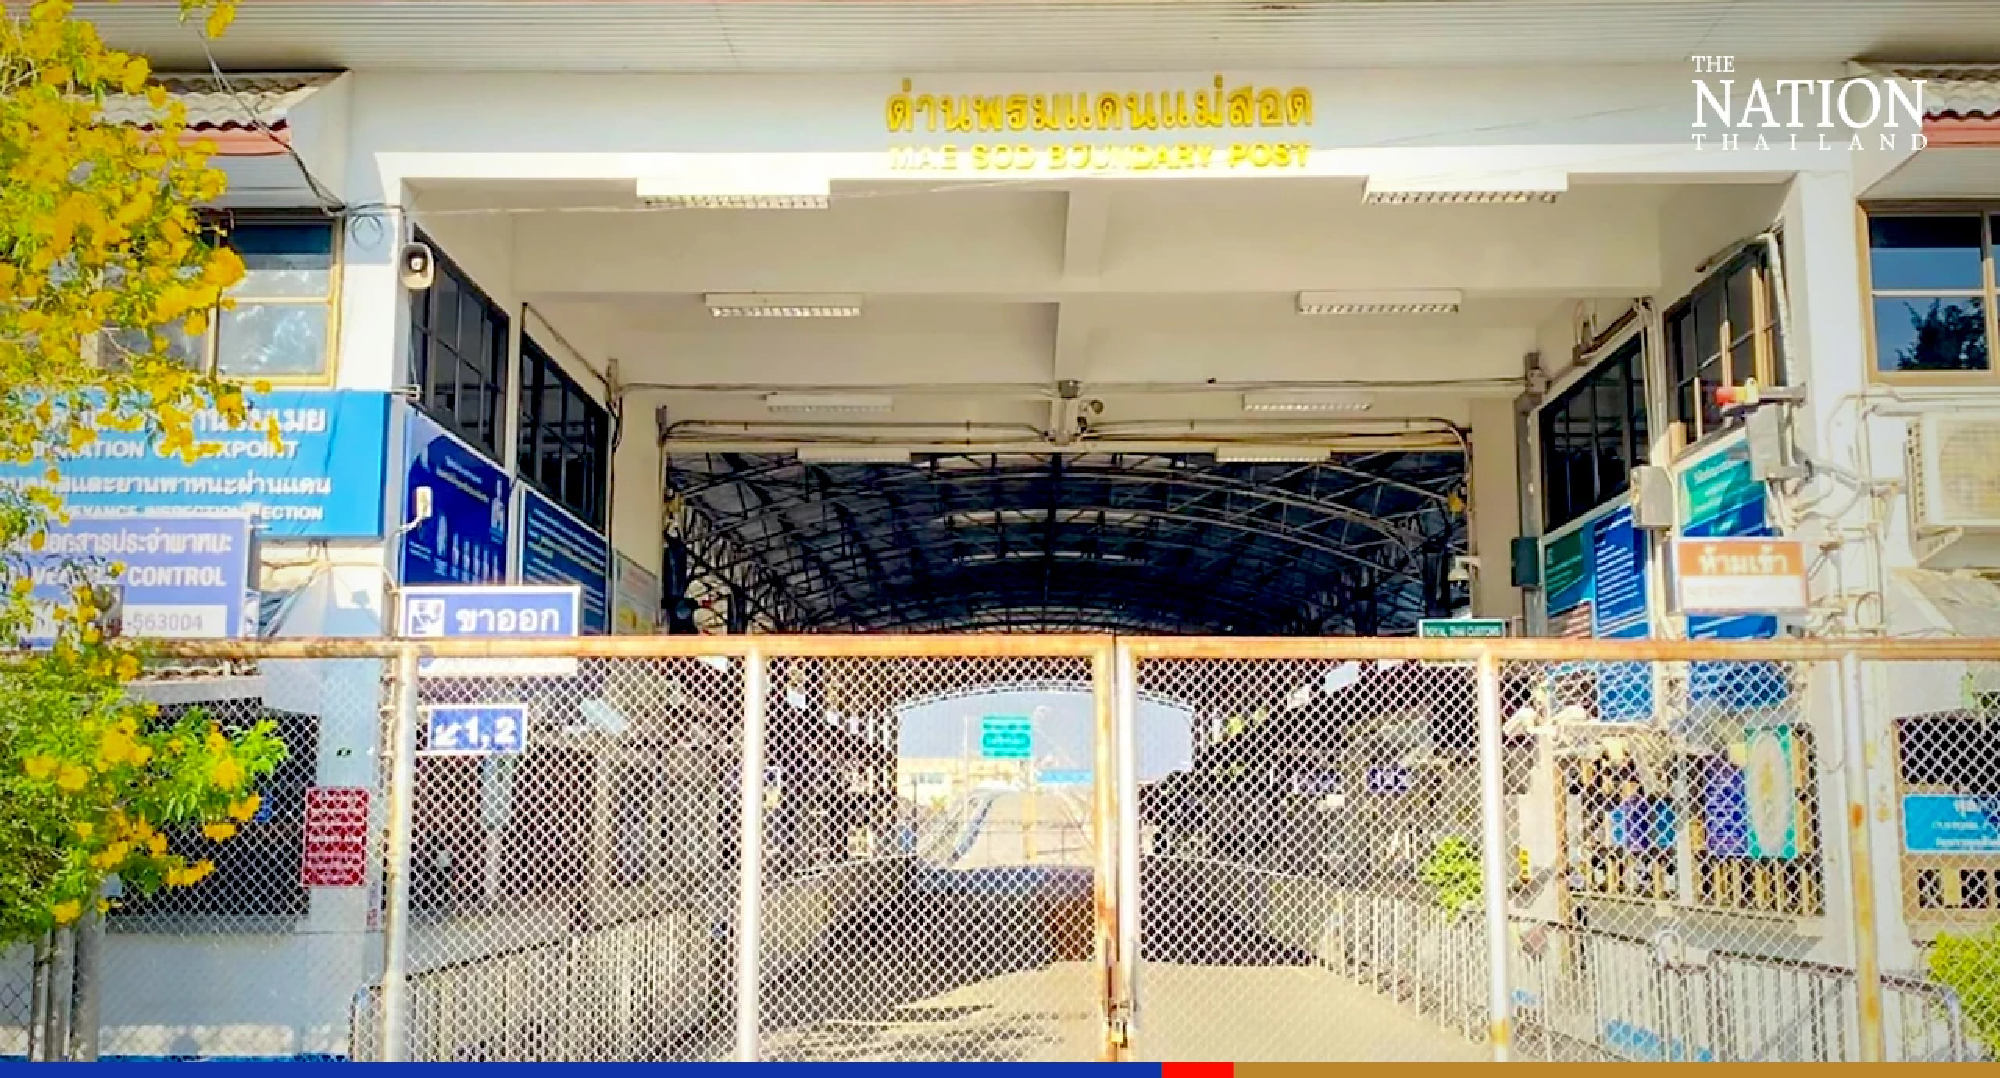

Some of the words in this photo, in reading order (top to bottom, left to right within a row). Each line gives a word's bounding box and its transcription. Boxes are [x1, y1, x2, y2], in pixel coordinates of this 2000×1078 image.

[886, 76, 1313, 133] ด่านพรมแดนแม่สอด
[889, 144, 958, 170] MAE
[972, 144, 1036, 170] SOD
[1229, 140, 1312, 169] POST
[260, 505, 325, 520] ECTION
[1697, 545, 1788, 575] ห้ามเข้า
[128, 565, 228, 587] CONTROL
[455, 608, 560, 632] ขาออก
[465, 716, 517, 749] 1,2
